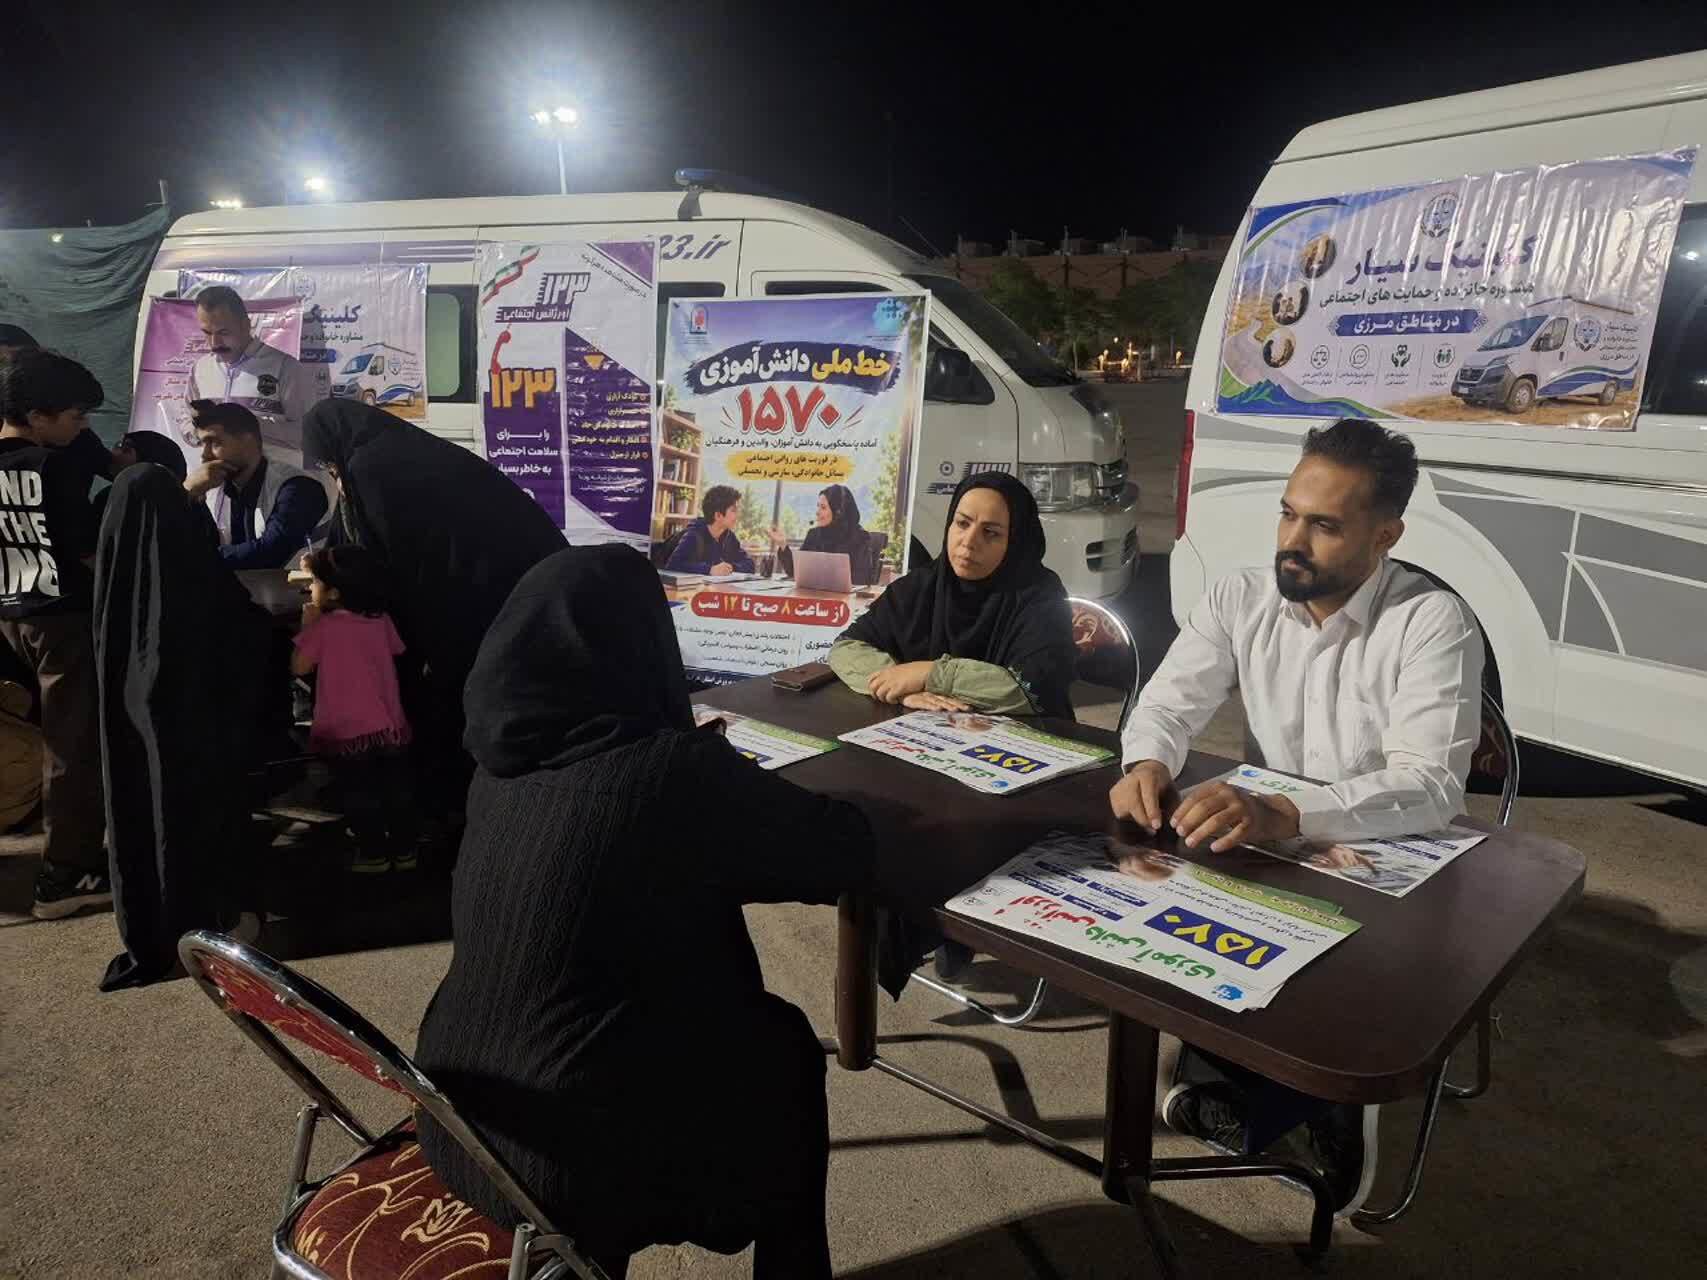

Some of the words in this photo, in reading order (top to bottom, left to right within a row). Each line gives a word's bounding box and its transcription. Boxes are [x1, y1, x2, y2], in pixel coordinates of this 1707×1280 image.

[1425, 234, 1538, 275] کینیک
[1346, 247, 1420, 284] سیار
[1319, 289, 1366, 308] اجتماعی
[1367, 287, 1391, 305] های
[1393, 285, 1434, 300] حمایت
[1489, 282, 1535, 299] مشاوره
[503, 307, 535, 321] اجتماعی
[536, 308, 570, 321] اورژانس
[1352, 315, 1393, 334] مرزی
[1396, 313, 1442, 334] مناطق
[1442, 314, 1461, 331] در
[700, 346, 761, 387] آموزی
[759, 349, 811, 380] دانش
[811, 348, 853, 380] ملی
[853, 351, 890, 378] خط
[489, 367, 557, 410] ۱۲۳
[736, 385, 842, 435] ۱۵۷۰
[496, 428, 542, 442] برای
[543, 428, 550, 441] را
[859, 437, 878, 448] آماده
[704, 438, 739, 448] فرهنگیان
[747, 438, 769, 448] والدین
[794, 438, 815, 449] دانش
[823, 439, 859, 451] پاسخگویی
[488, 446, 526, 459] اجتماعی
[527, 446, 558, 457] سلامت
[519, 463, 542, 476] خاطر
[542, 465, 552, 476] به
[0, 511, 52, 546] THE
[698, 596, 720, 610] شب
[724, 595, 738, 611] ۱۲
[741, 597, 751, 611] تا
[753, 602, 779, 617] صبح
[781, 602, 791, 615] ۸
[794, 602, 829, 618] ساعت
[831, 604, 845, 623] از
[975, 745, 1040, 774] ۱۵۷۰
[996, 893, 1099, 930] اورژانس
[1083, 922, 1148, 951] دانش
[1123, 937, 1217, 982] آموزی
[1165, 912, 1273, 967] ۱۵۷۰
